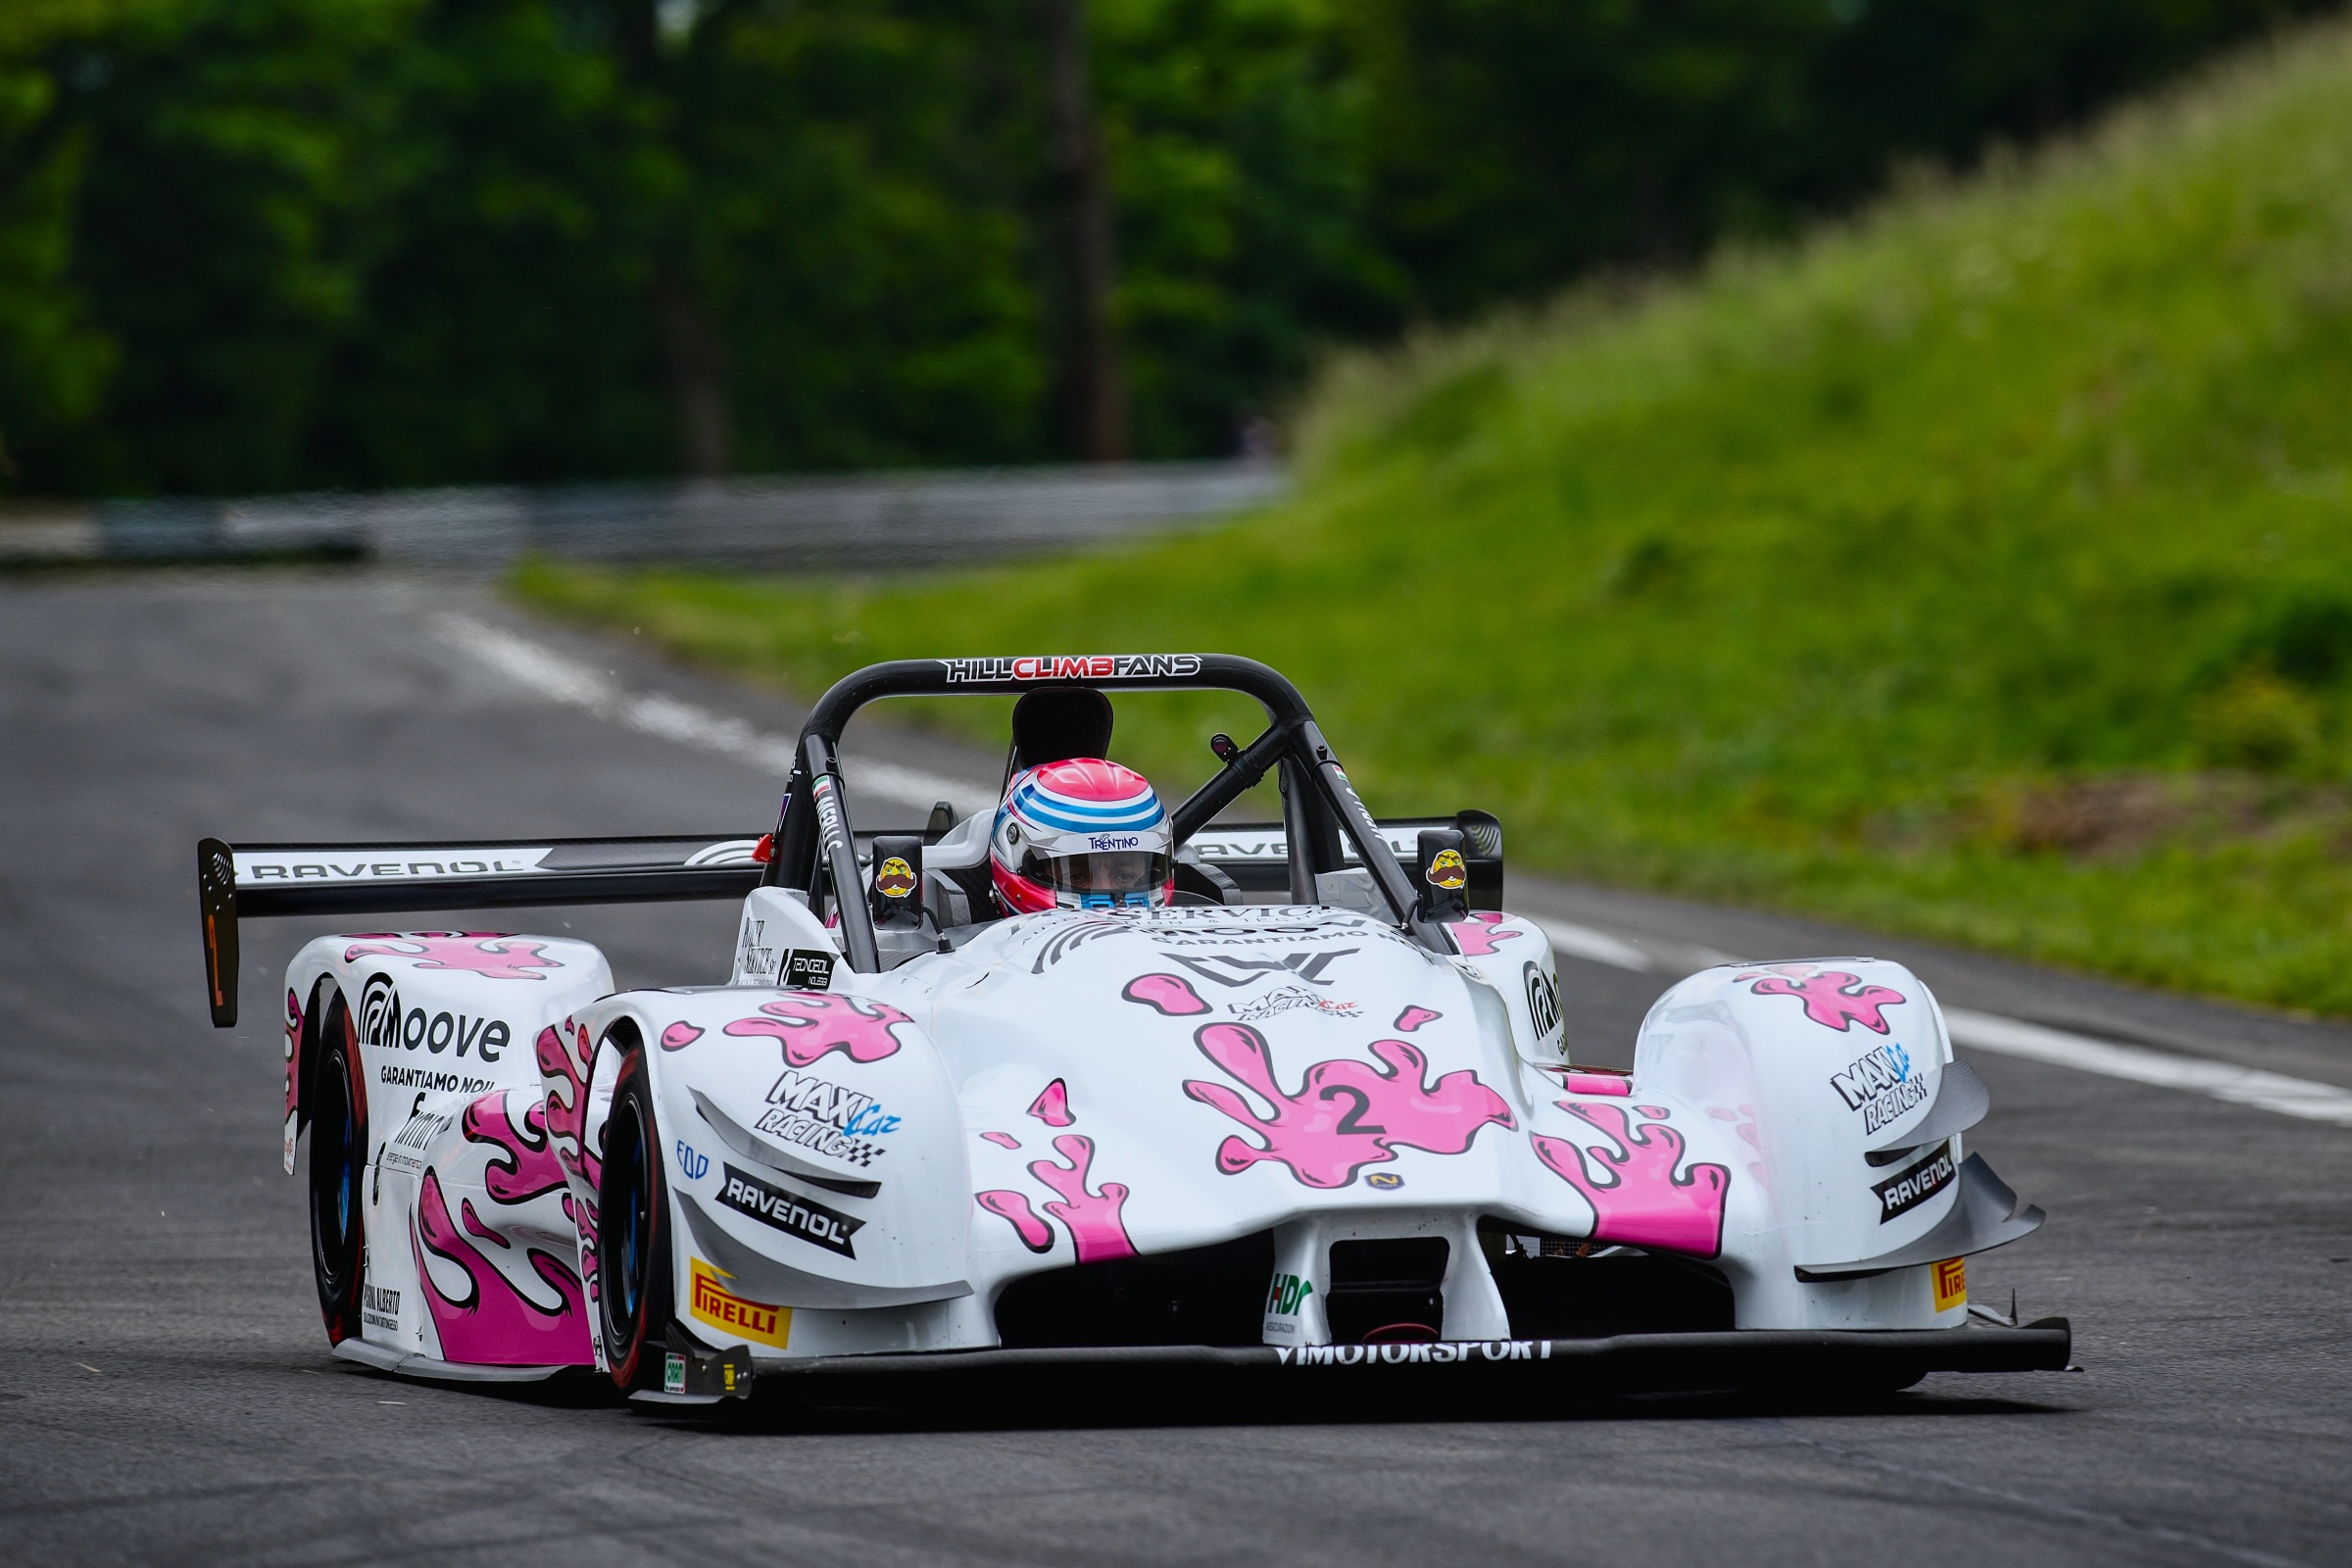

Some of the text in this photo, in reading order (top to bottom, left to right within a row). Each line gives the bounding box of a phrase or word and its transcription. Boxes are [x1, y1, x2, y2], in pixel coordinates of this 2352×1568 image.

[936, 654, 1203, 683] HILLCLIMBFANS
[1088, 836, 1139, 851] TRENTINO
[1196, 838, 1419, 858] AVEL
[250, 859, 525, 880] RAVENOL
[1106, 906, 1331, 921] SERVIC
[1151, 931, 1369, 946] GARANTIAMO
[380, 1064, 459, 1093] GARANTIAMO
[1319, 1084, 1388, 1136] 2
[1863, 1078, 1921, 1137] RACING
[753, 1107, 855, 1159] RACING
[1884, 1153, 1953, 1211] RAVENOL
[726, 1177, 846, 1246] RAVENOL
[376, 1287, 401, 1316] ALBERTO
[694, 1271, 781, 1336] PIRELLI
